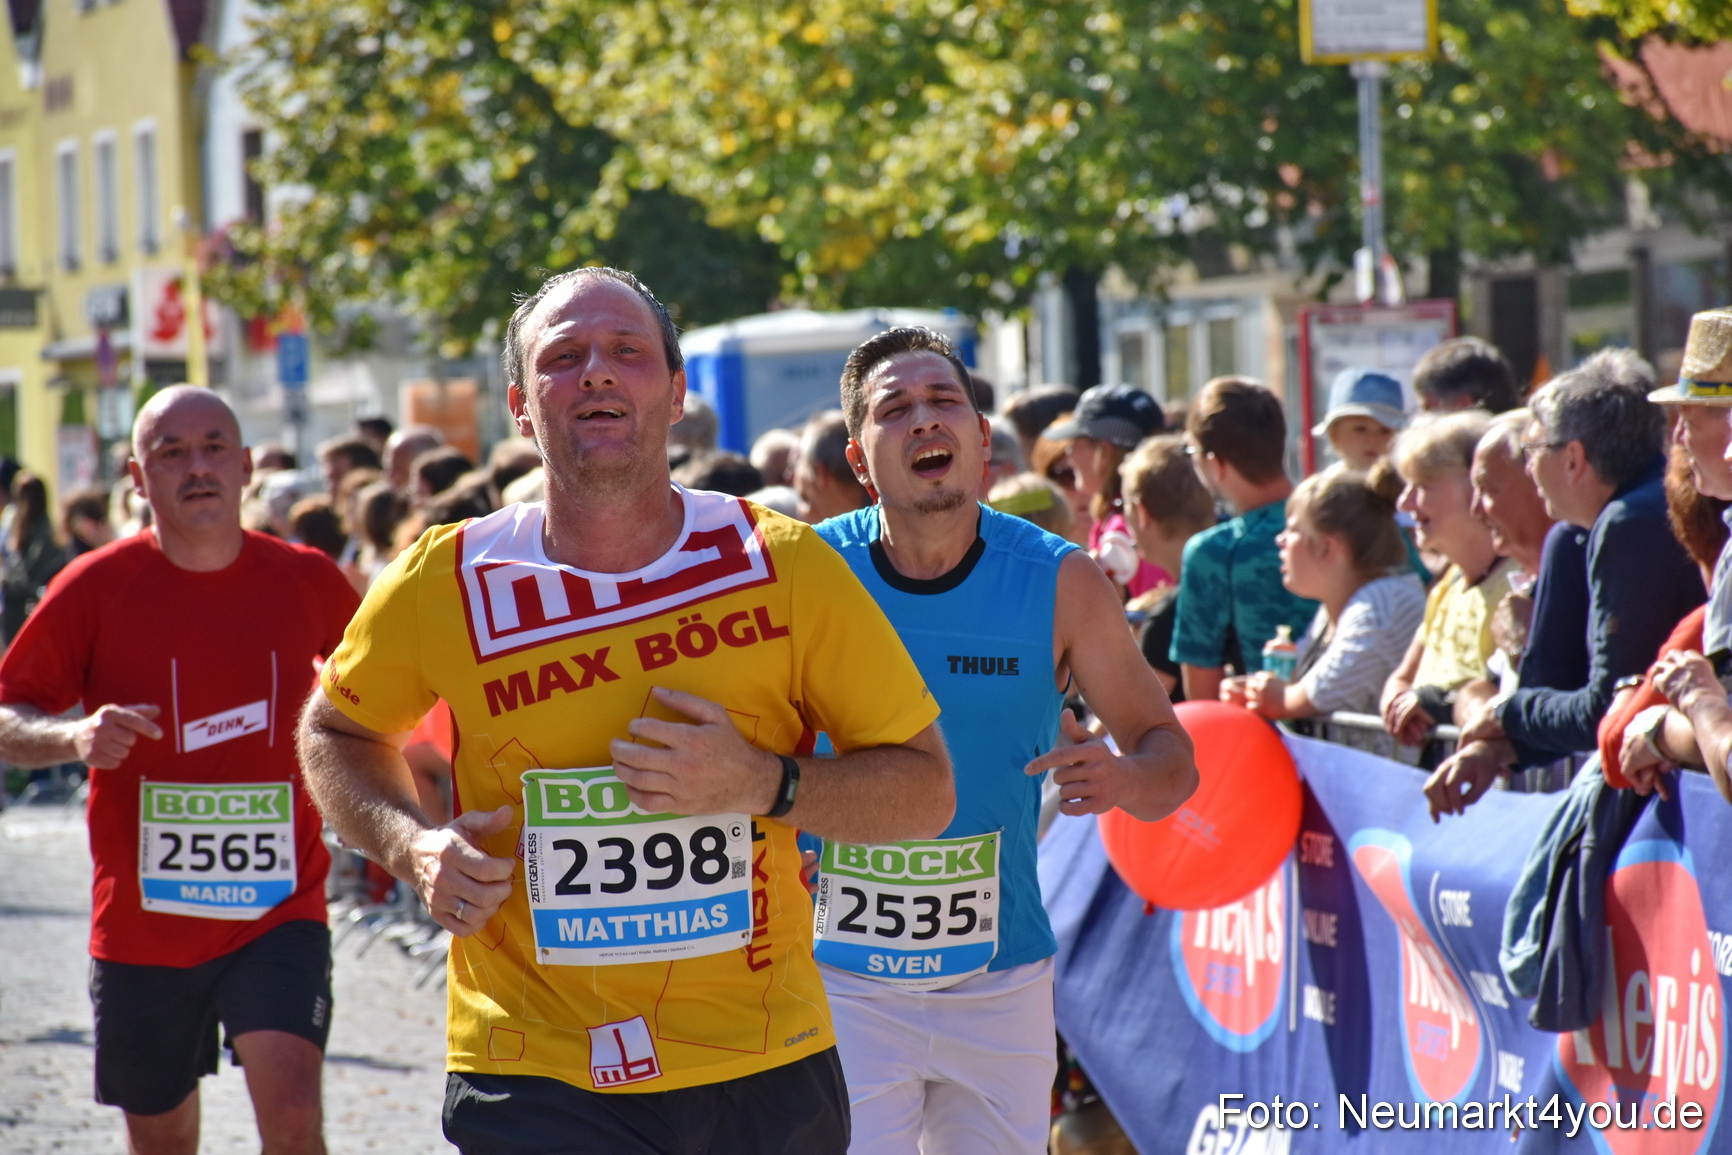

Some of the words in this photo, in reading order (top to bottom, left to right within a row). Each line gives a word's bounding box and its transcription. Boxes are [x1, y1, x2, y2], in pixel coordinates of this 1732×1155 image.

[483, 646, 621, 717] MAX
[635, 605, 790, 671] BÖGL
[947, 655, 1019, 675] THULE
[207, 715, 245, 737] DEHN
[156, 793, 277, 817] BOCK
[731, 826, 742, 837] C
[158, 832, 277, 873] 2565
[552, 826, 730, 896] 2398
[837, 844, 980, 877] BOCK
[180, 884, 258, 904] MARIO
[983, 891, 992, 900] D
[837, 886, 977, 941] 2535
[1439, 889, 1473, 928] STORE
[557, 903, 729, 943] MATTHIAS
[866, 953, 942, 974] SVEN
